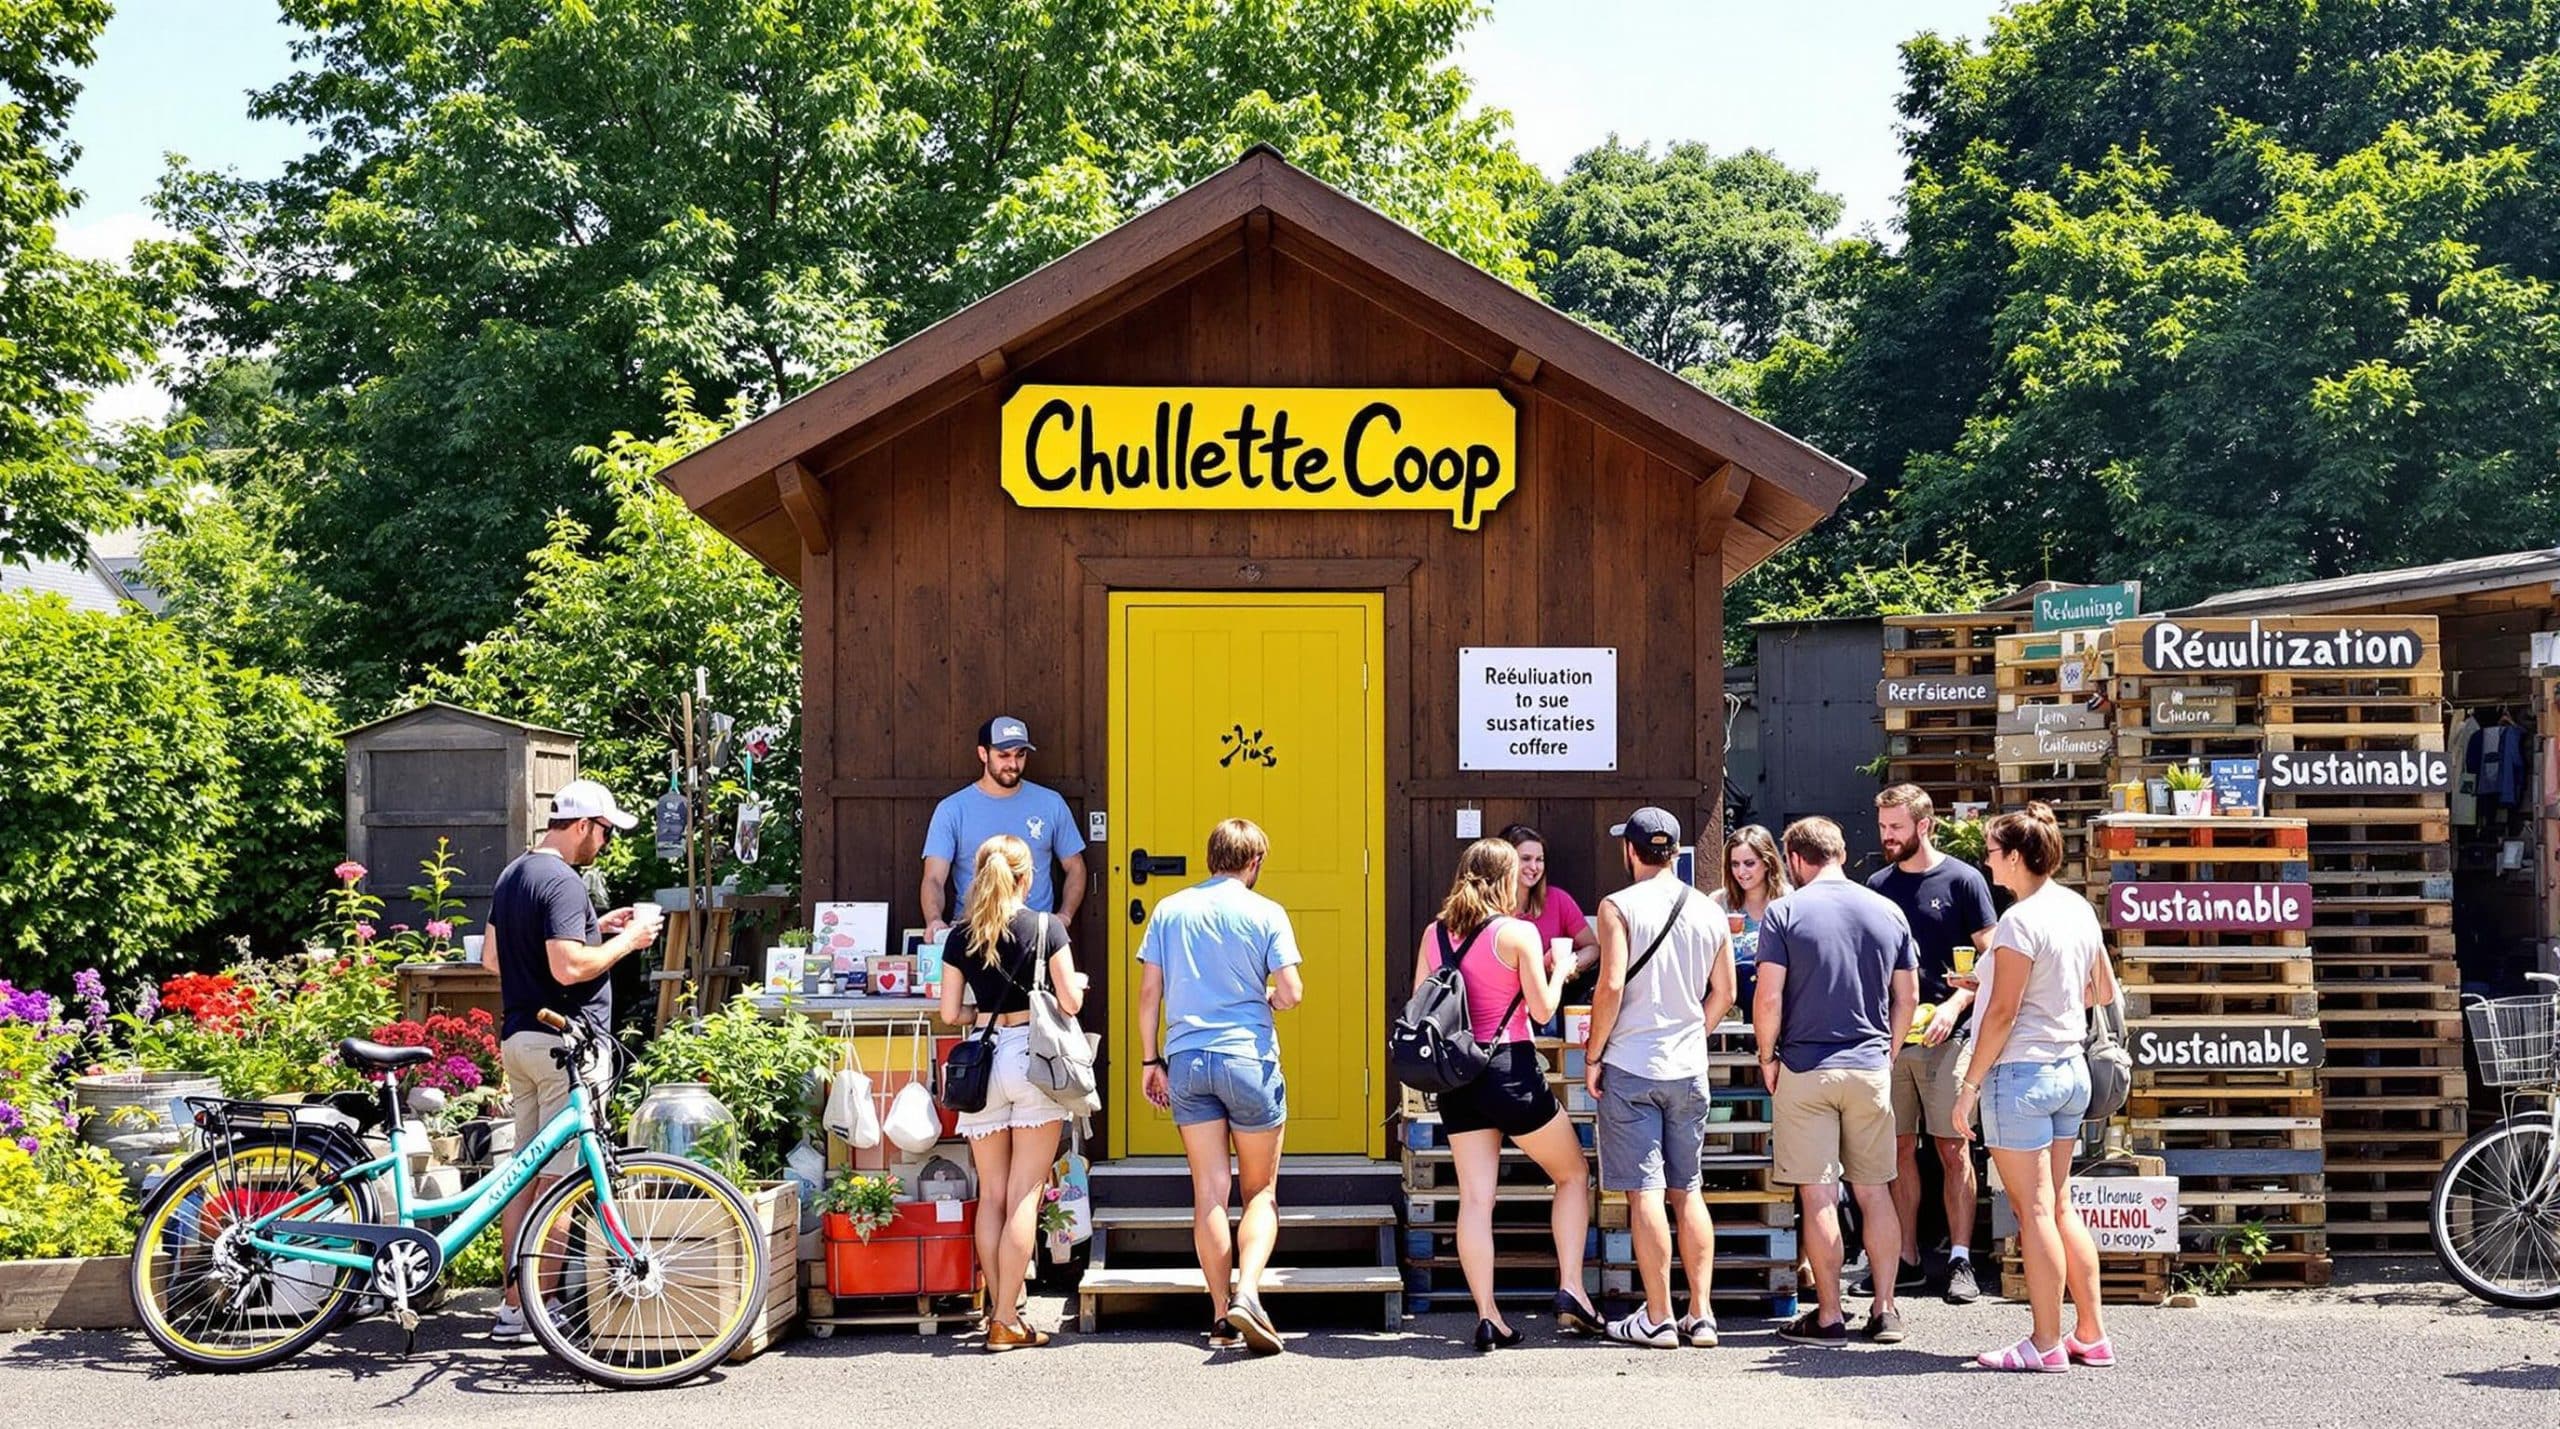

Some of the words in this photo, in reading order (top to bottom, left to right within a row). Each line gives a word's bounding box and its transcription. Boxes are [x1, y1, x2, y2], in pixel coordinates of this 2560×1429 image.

[1025, 398, 1337, 495] Chullette
[1344, 401, 1501, 526] Coop
[2155, 618, 2413, 669] Réuuliization
[1516, 692, 1533, 708] to
[1538, 695, 1570, 708] sue
[2271, 750, 2448, 787] Sustainable
[2138, 1028, 2310, 1065] Sustainable
